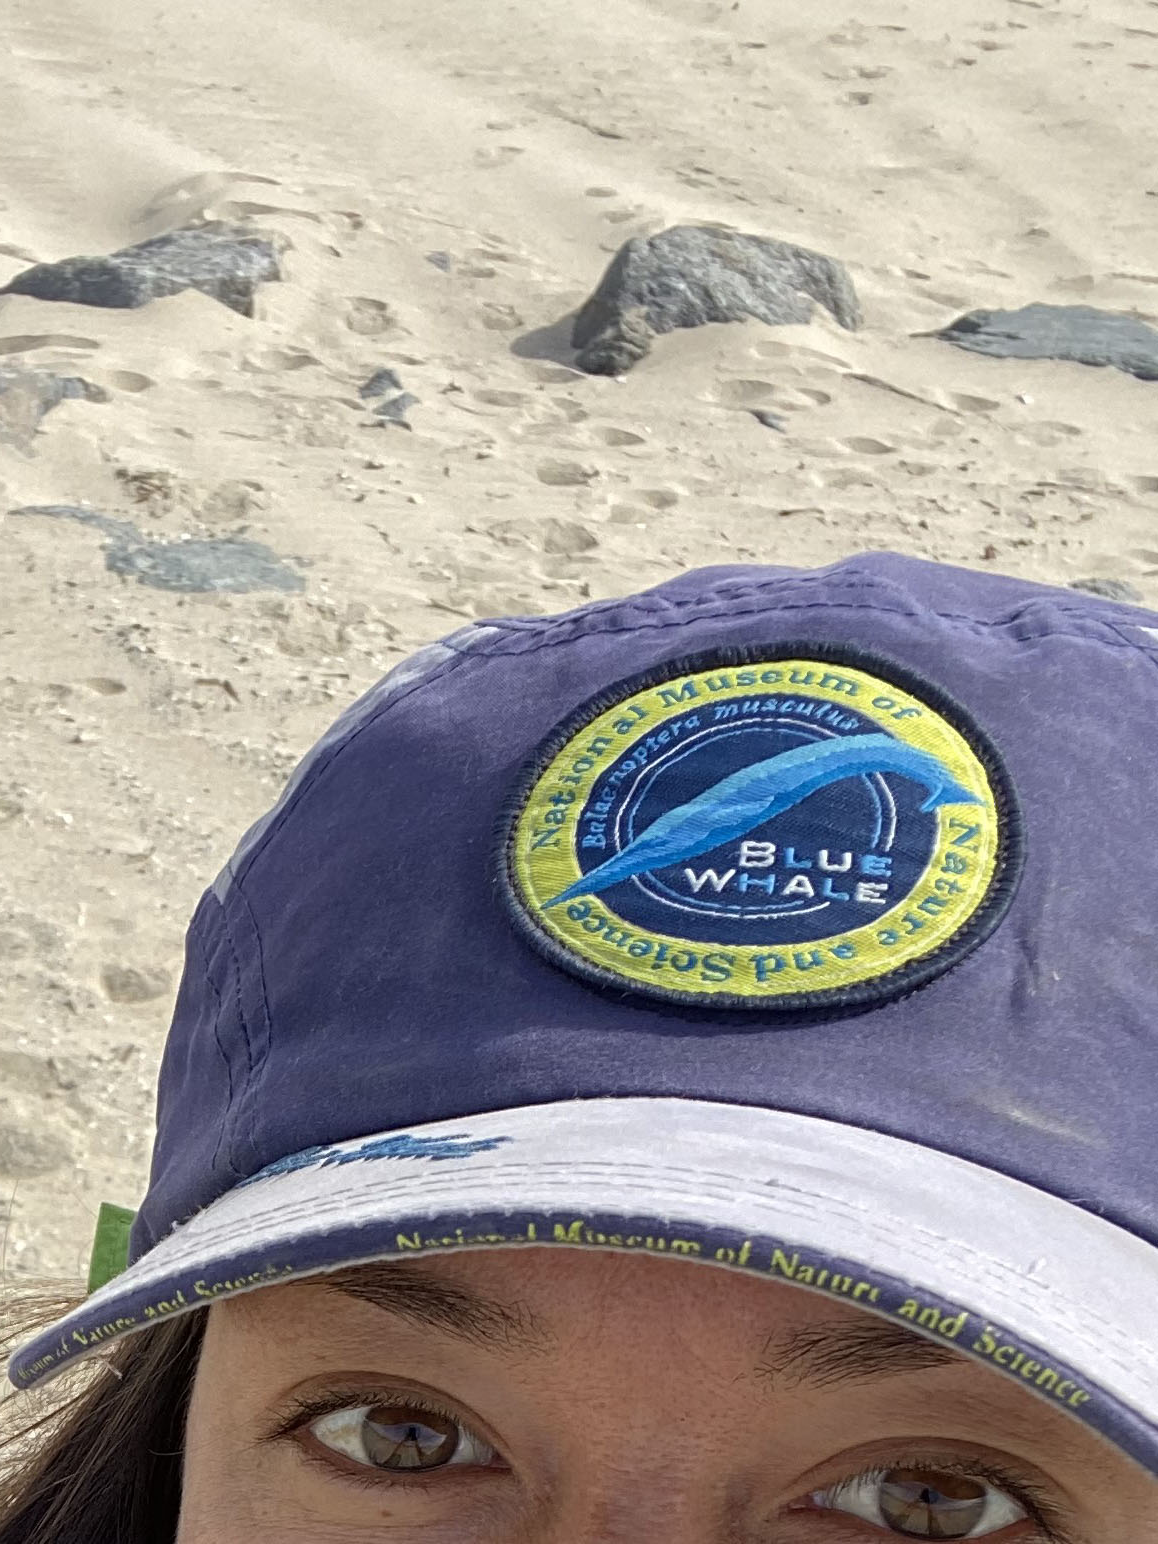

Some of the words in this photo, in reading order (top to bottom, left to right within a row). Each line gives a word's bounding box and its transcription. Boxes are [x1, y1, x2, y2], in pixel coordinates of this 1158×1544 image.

[655, 669, 862, 709] Museum
[871, 696, 923, 720] of
[531, 703, 650, 851] National
[581, 714, 702, 850] Balaenoptera
[714, 698, 860, 731] musculus
[684, 867, 890, 905] WHALE
[739, 839, 893, 878] BLUE
[875, 817, 981, 948] Nature
[565, 898, 737, 983] Science
[749, 941, 859, 983] and
[396, 1222, 536, 1250] Nainl
[897, 1297, 971, 1339] and
[972, 1325, 1091, 1408] Science
